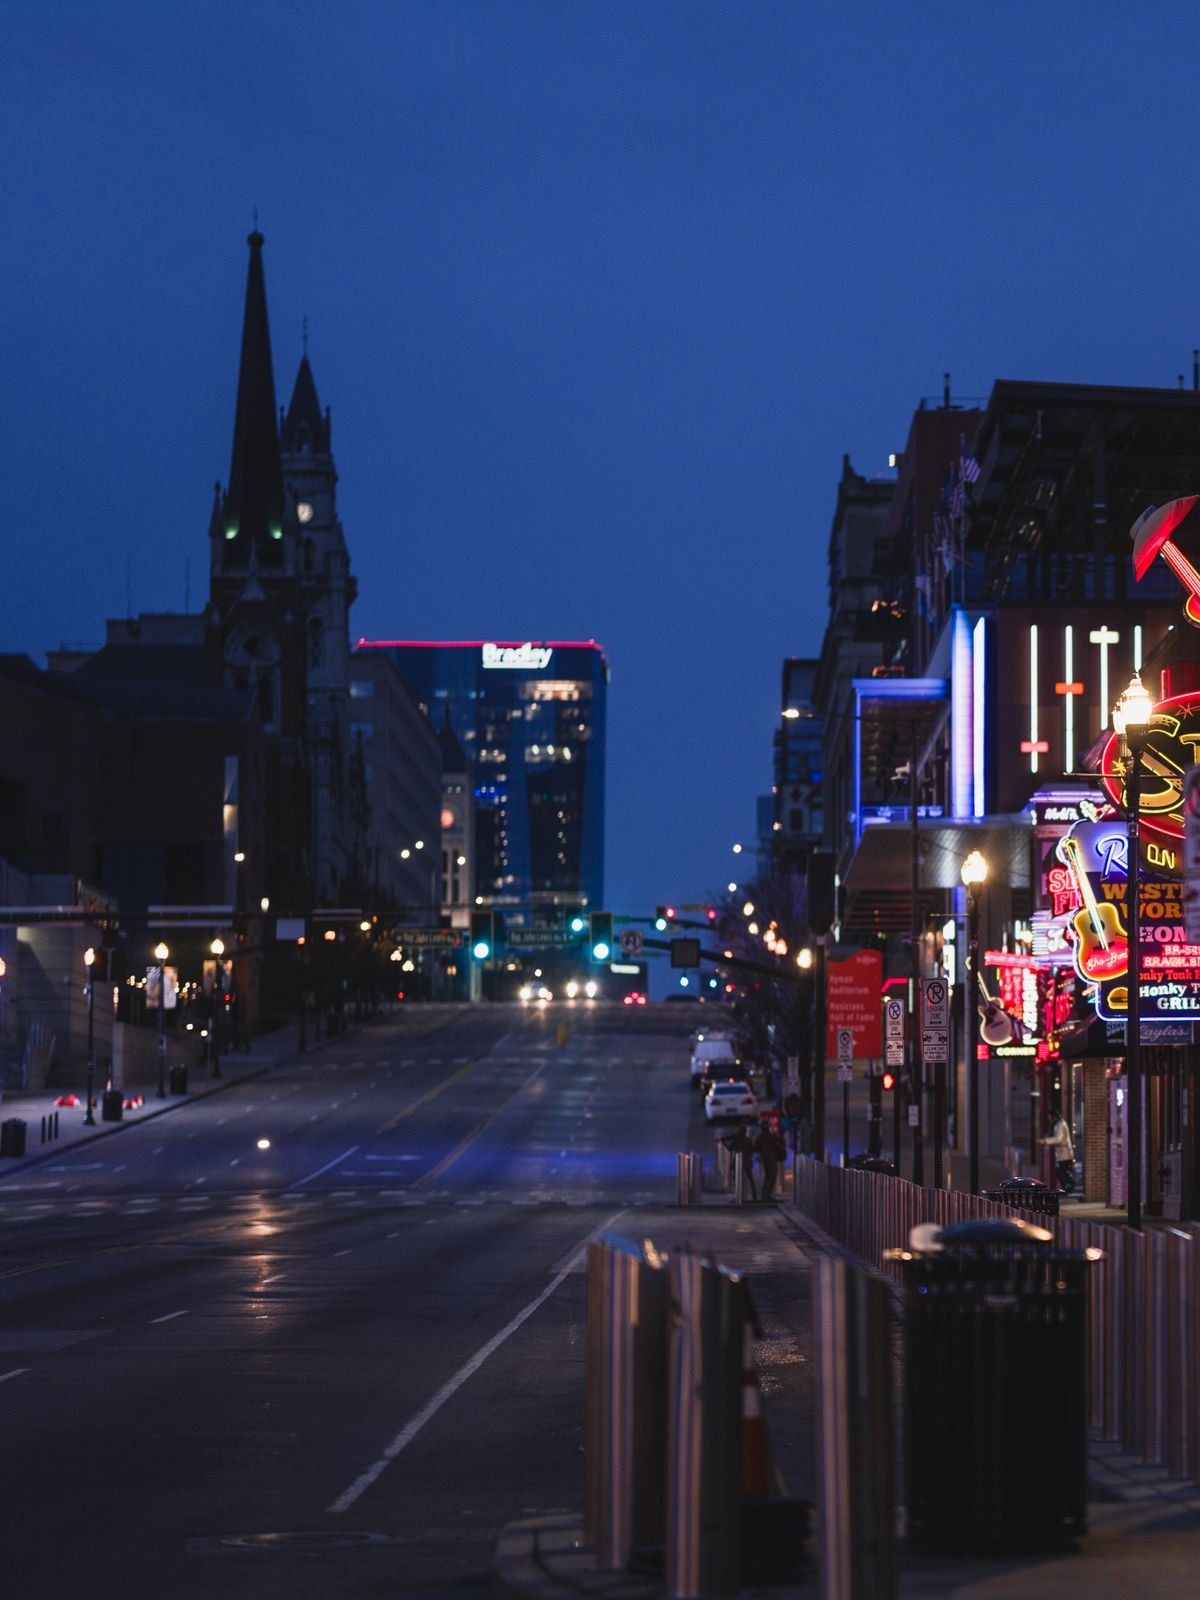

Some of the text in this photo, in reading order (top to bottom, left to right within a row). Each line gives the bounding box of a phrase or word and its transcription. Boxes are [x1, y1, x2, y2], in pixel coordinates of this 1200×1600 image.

[1147, 843, 1176, 870] ON
[1166, 969, 1193, 981] Tonk
[1139, 983, 1188, 998] Honky
[996, 1047, 1036, 1056] CORNER
